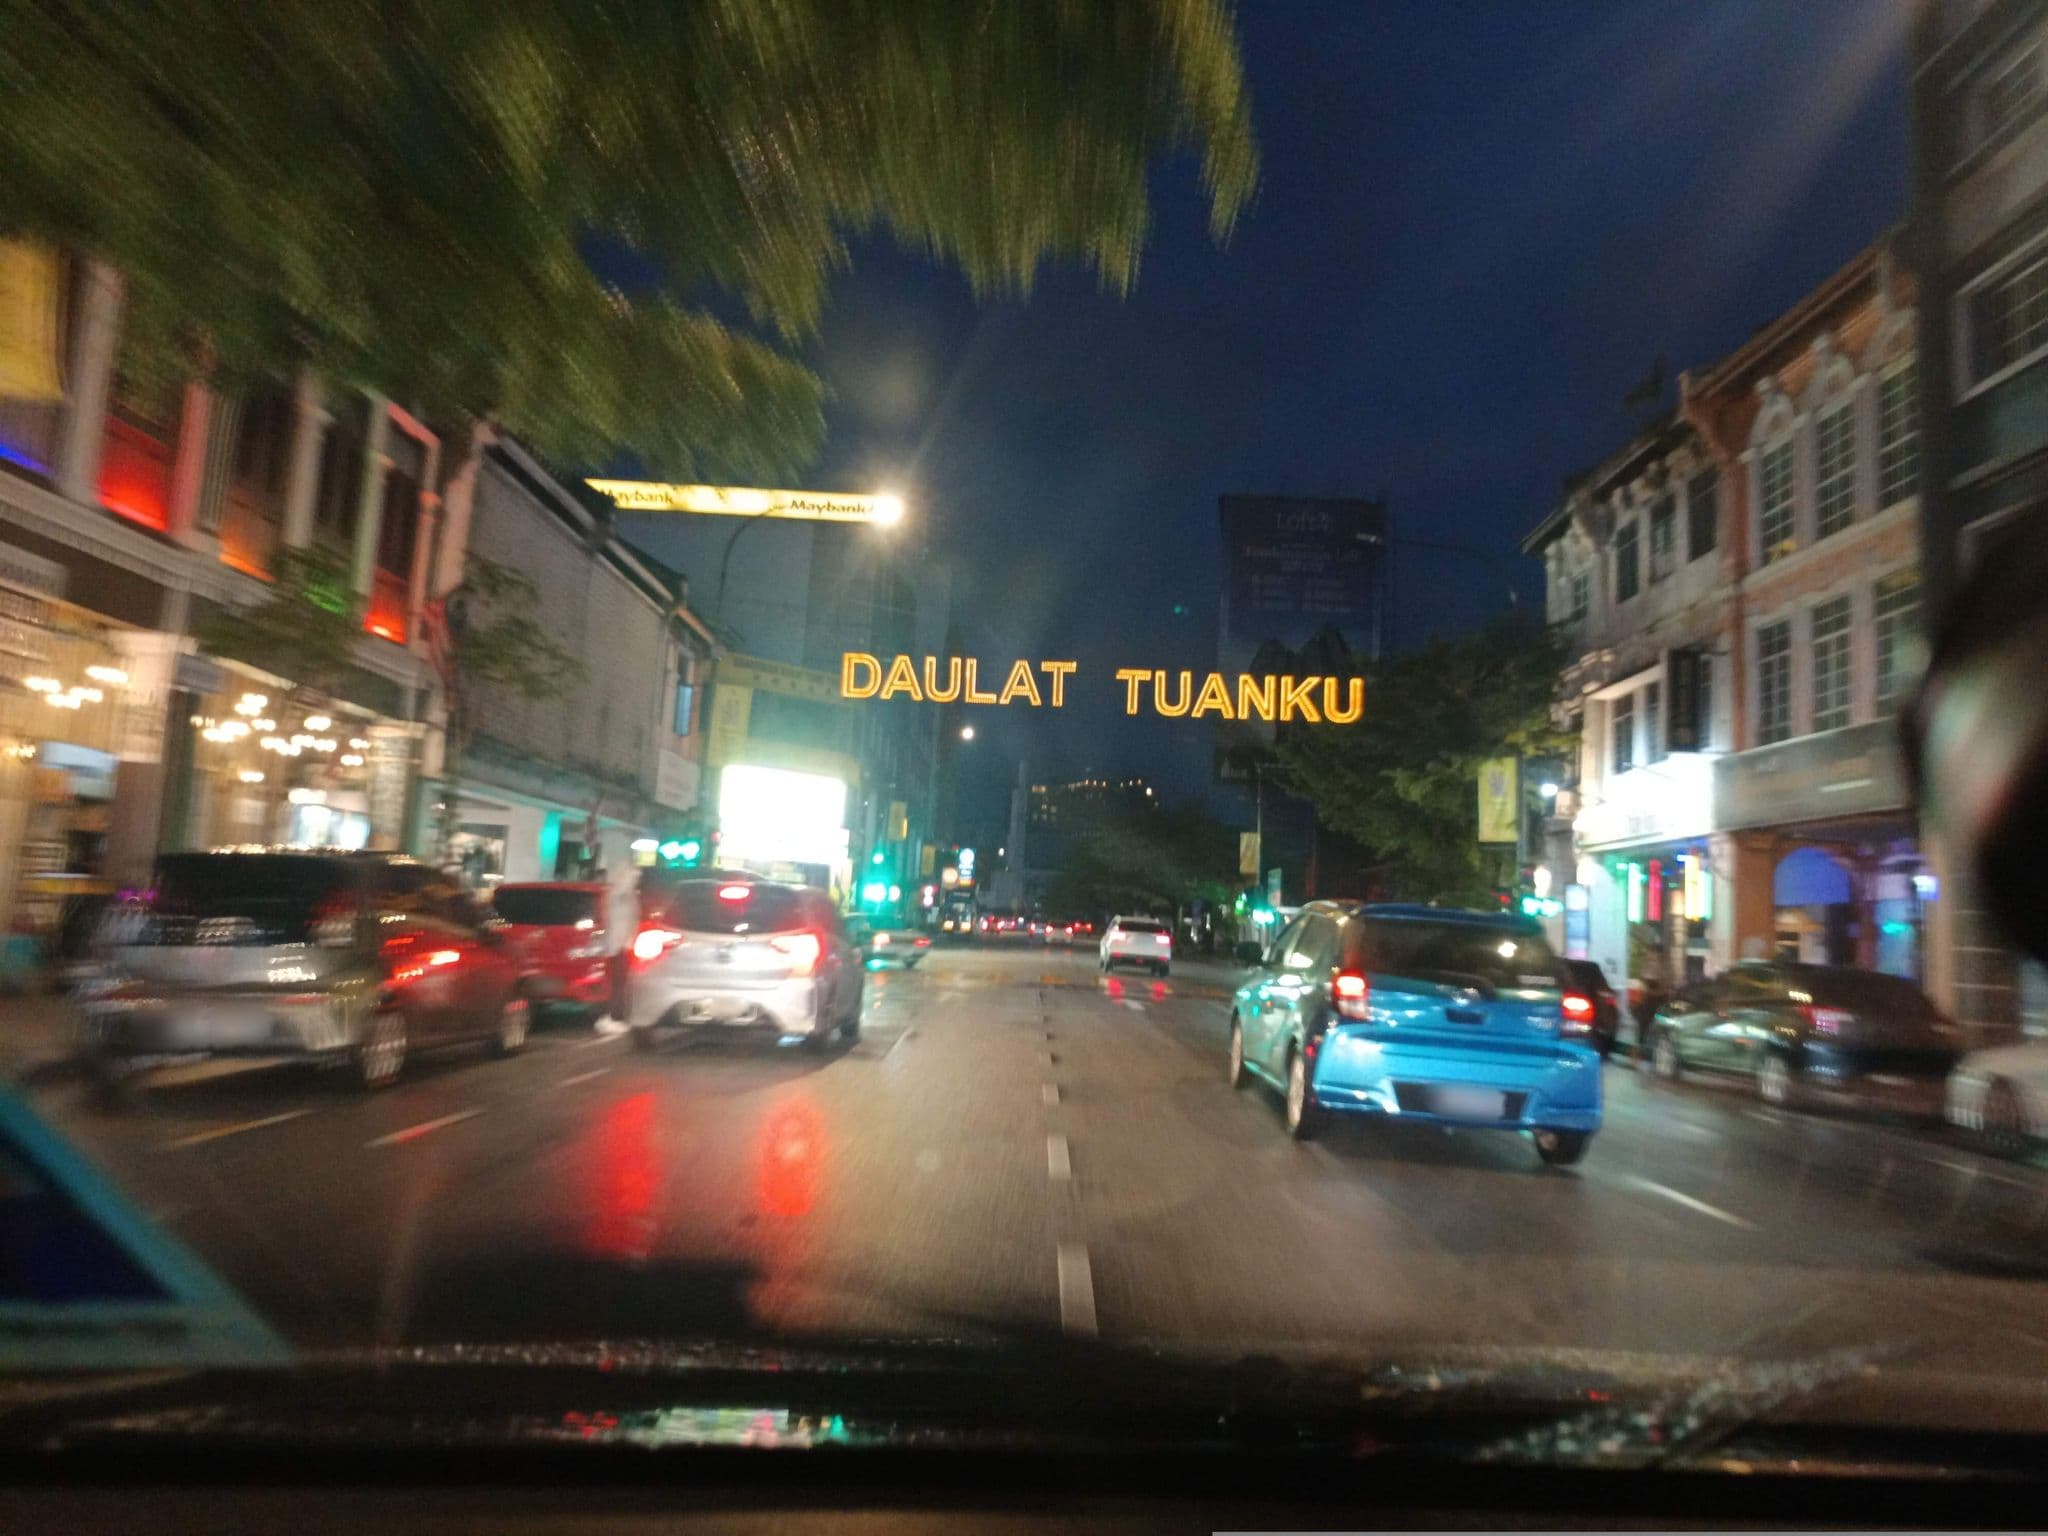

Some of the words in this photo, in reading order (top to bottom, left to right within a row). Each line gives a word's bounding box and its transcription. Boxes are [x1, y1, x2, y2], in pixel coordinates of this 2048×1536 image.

[790, 499, 862, 514] Maybank
[840, 651, 1077, 708] DAULAT
[1115, 668, 1364, 724] TUANKU
